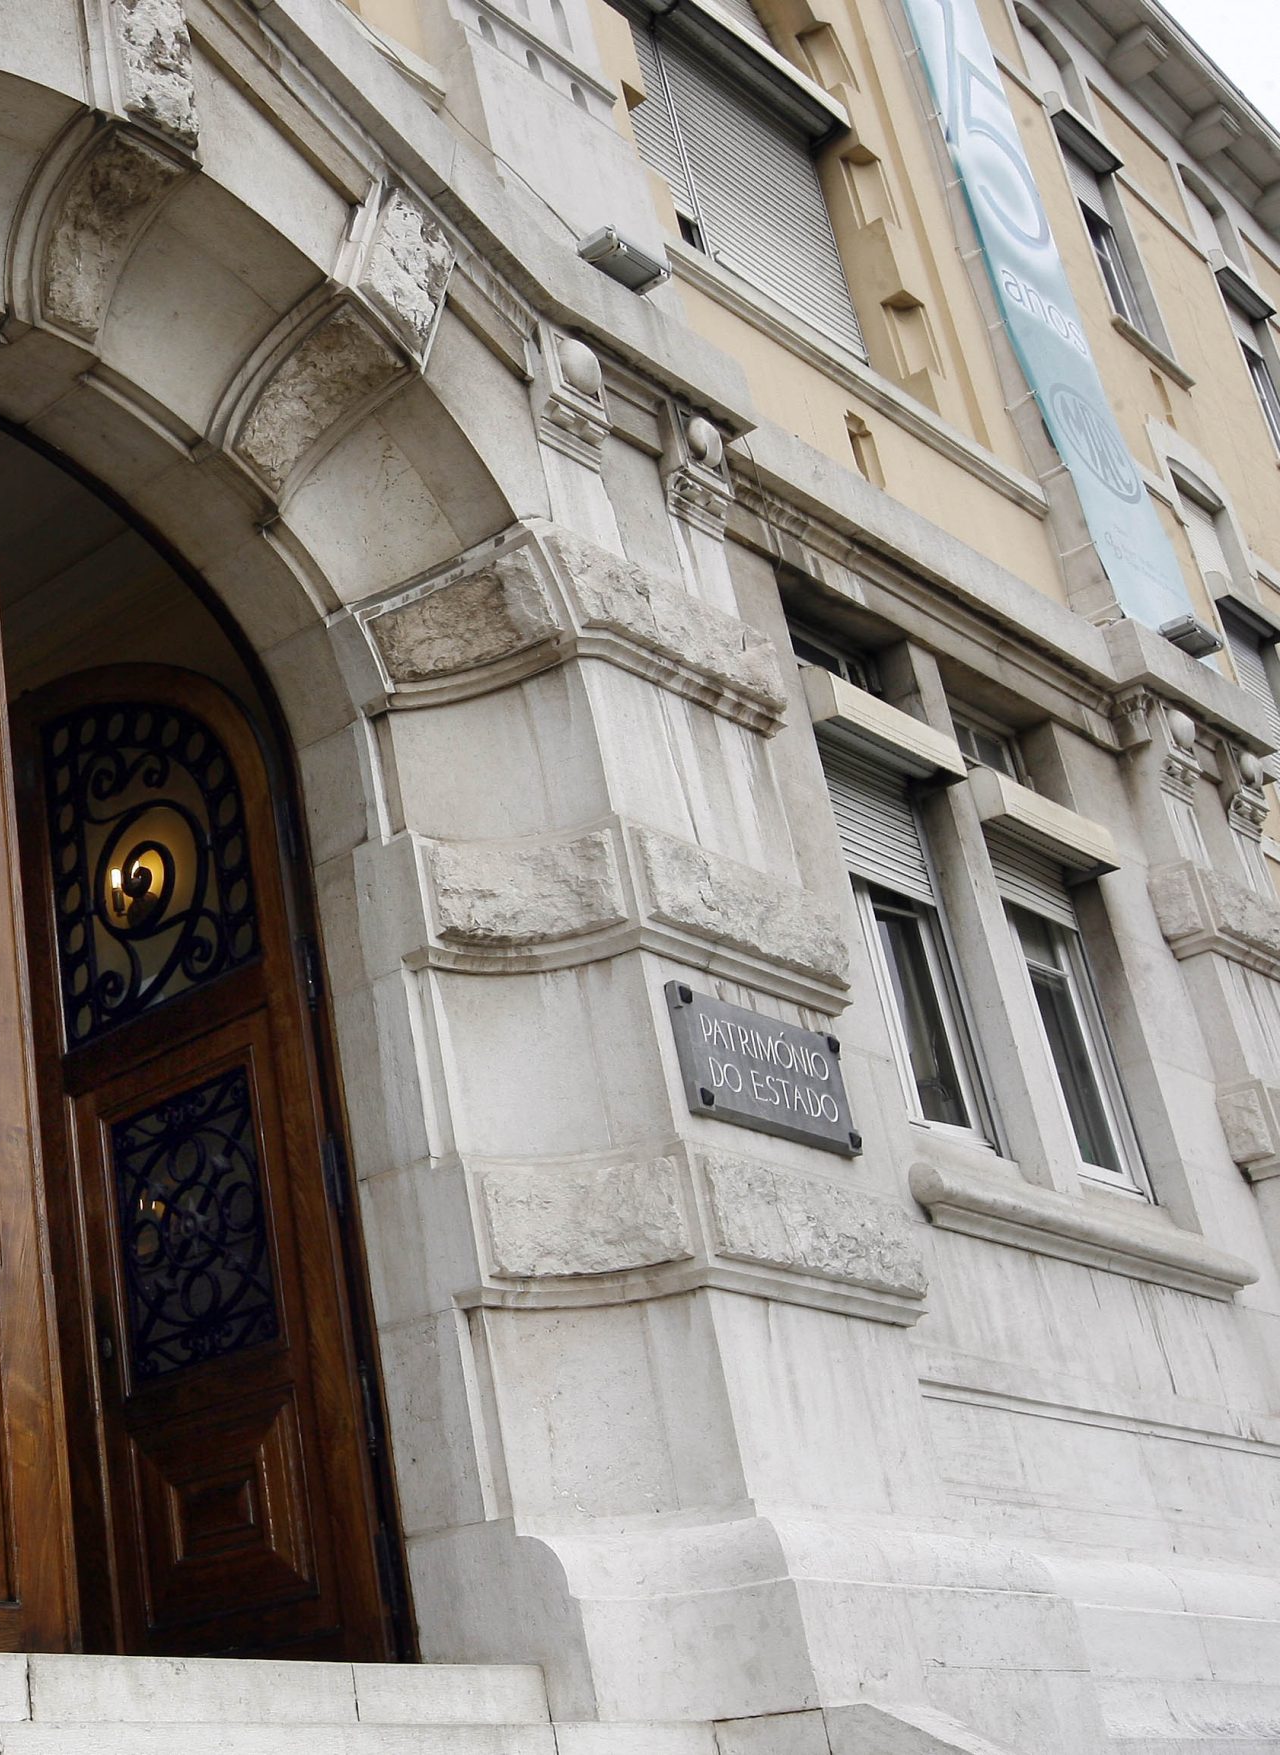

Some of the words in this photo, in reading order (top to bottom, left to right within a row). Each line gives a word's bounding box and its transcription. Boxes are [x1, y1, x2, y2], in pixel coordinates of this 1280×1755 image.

[1001, 269, 1087, 355] anos
[699, 1013, 829, 1081] PATRIMÓNIO
[708, 1056, 742, 1093] DO
[750, 1070, 839, 1123] ESTADO
